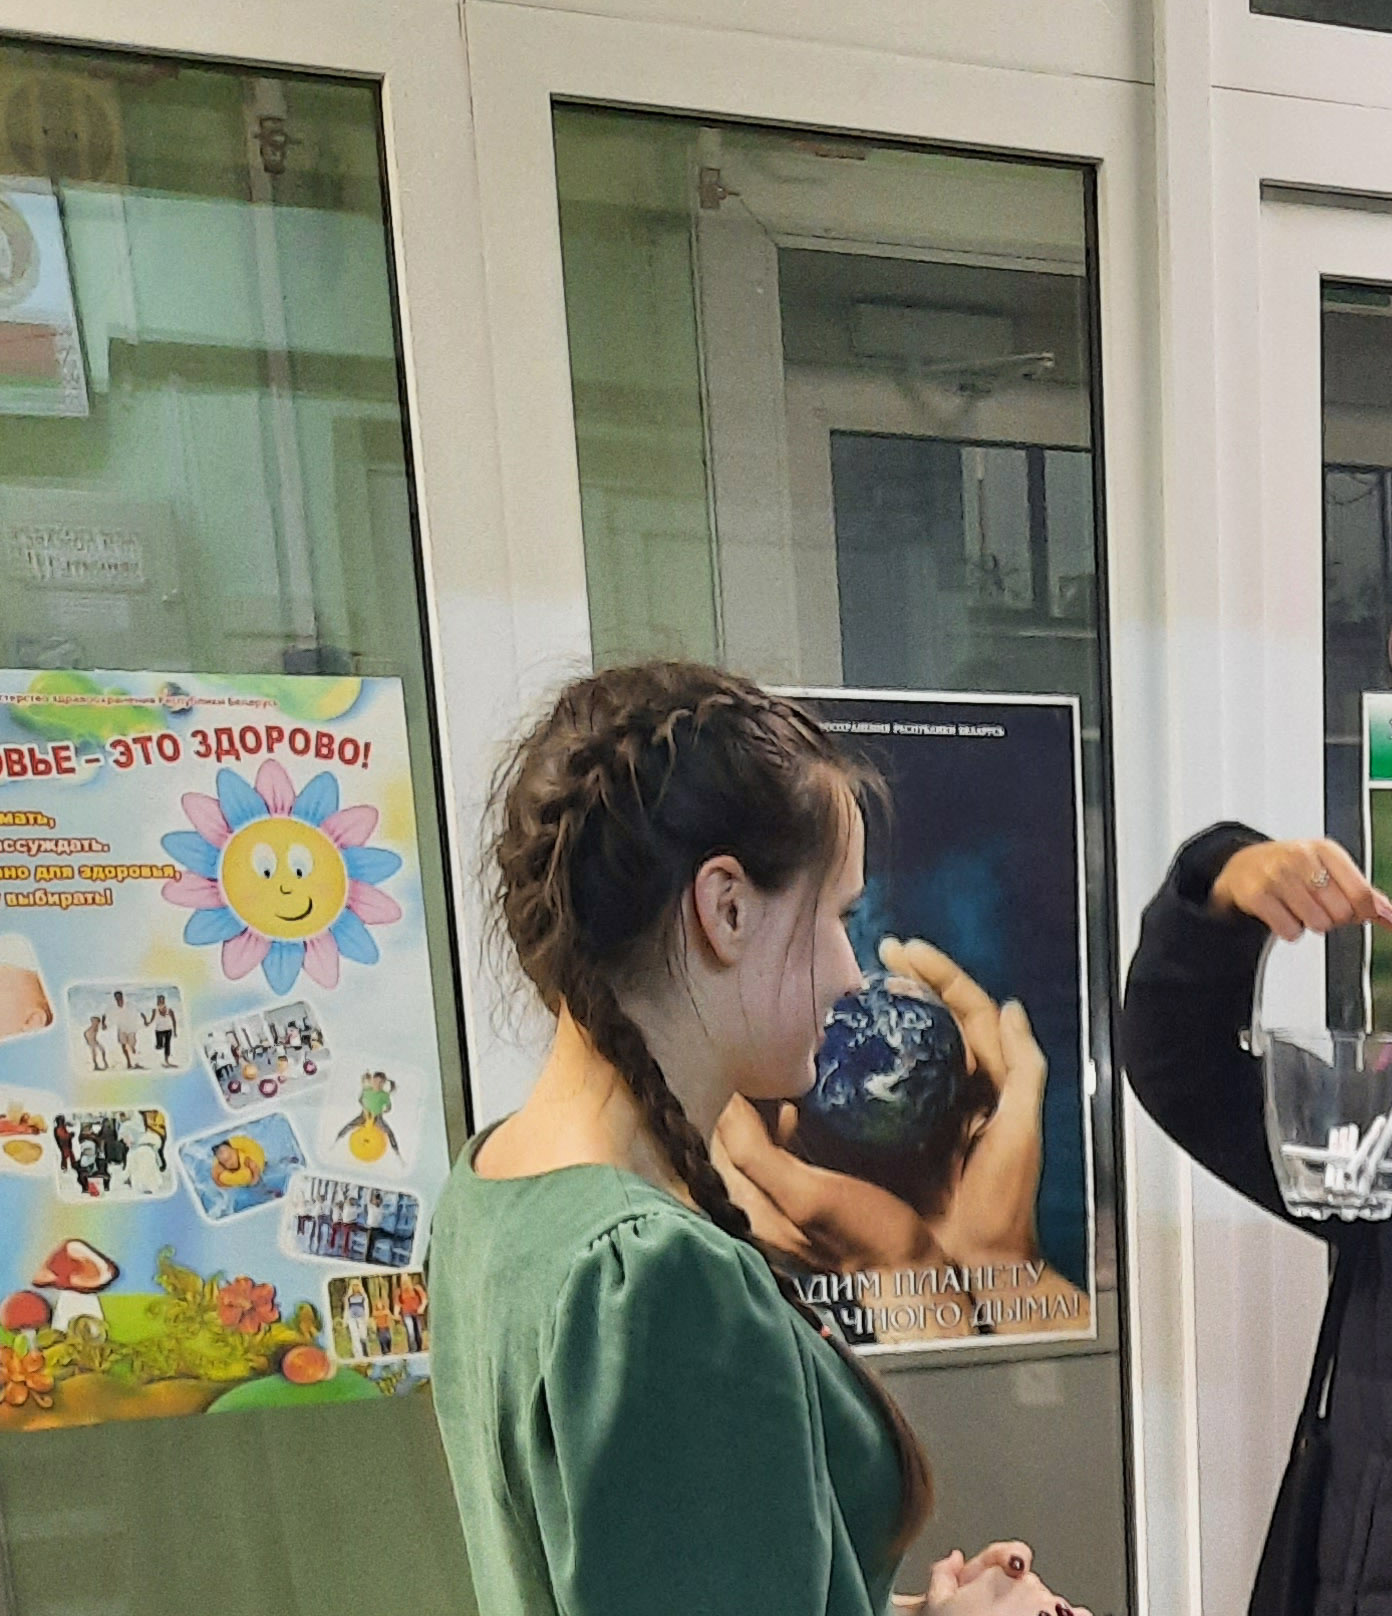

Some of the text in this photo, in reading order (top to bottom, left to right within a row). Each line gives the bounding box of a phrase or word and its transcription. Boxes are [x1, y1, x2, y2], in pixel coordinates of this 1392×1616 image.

[0, 745, 76, 778] ВЬЕ
[113, 733, 182, 769] ЭТО
[193, 724, 372, 769] ЗДОРОВО!
[0, 838, 110, 857] ссуждать.
[35, 864, 74, 882] для
[79, 864, 183, 882] здоровья,
[5, 888, 113, 908] выбирать!
[895, 1259, 1047, 1297] ПЛАНЕТУ
[972, 1293, 1081, 1328] ДЫМА!
